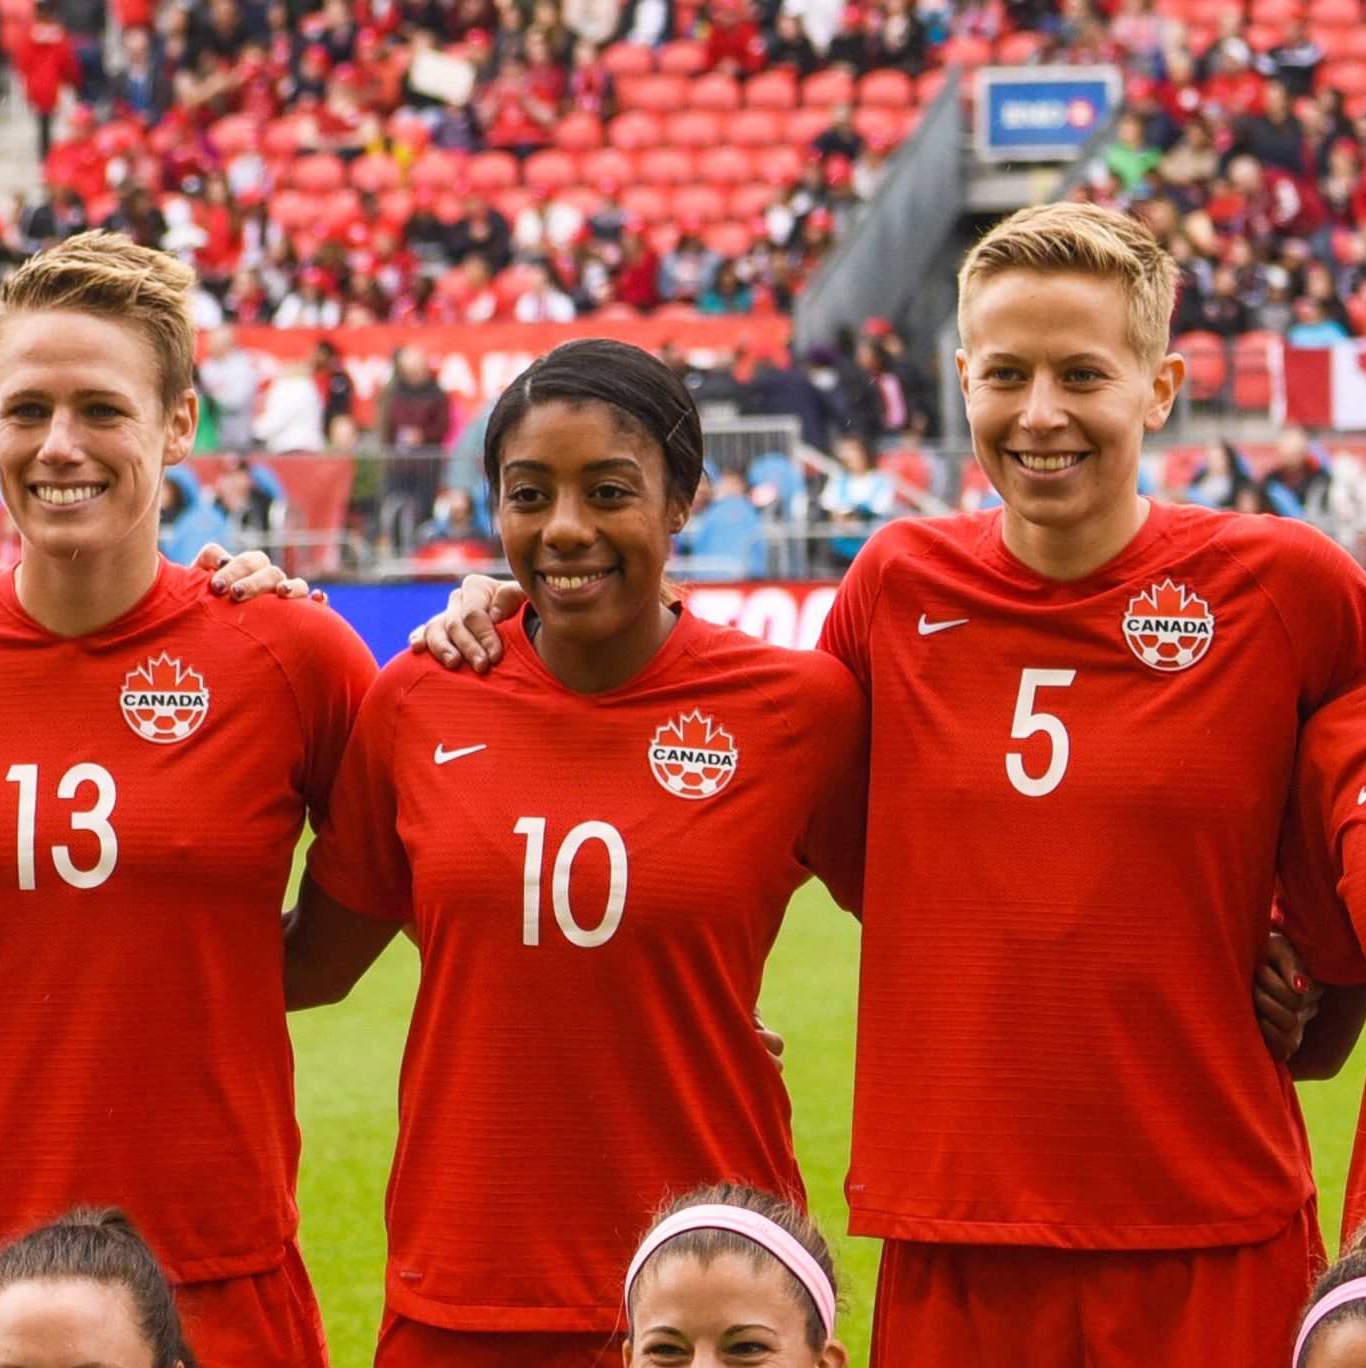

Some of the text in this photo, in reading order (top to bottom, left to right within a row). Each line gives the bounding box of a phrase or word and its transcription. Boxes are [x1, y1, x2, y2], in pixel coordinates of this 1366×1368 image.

[1126, 619, 1209, 634] CANADA
[123, 694, 204, 706] CANADA
[1006, 668, 1076, 797] 5
[653, 748, 732, 766] CANADA
[6, 763, 117, 890] 13
[513, 817, 628, 948] 10
